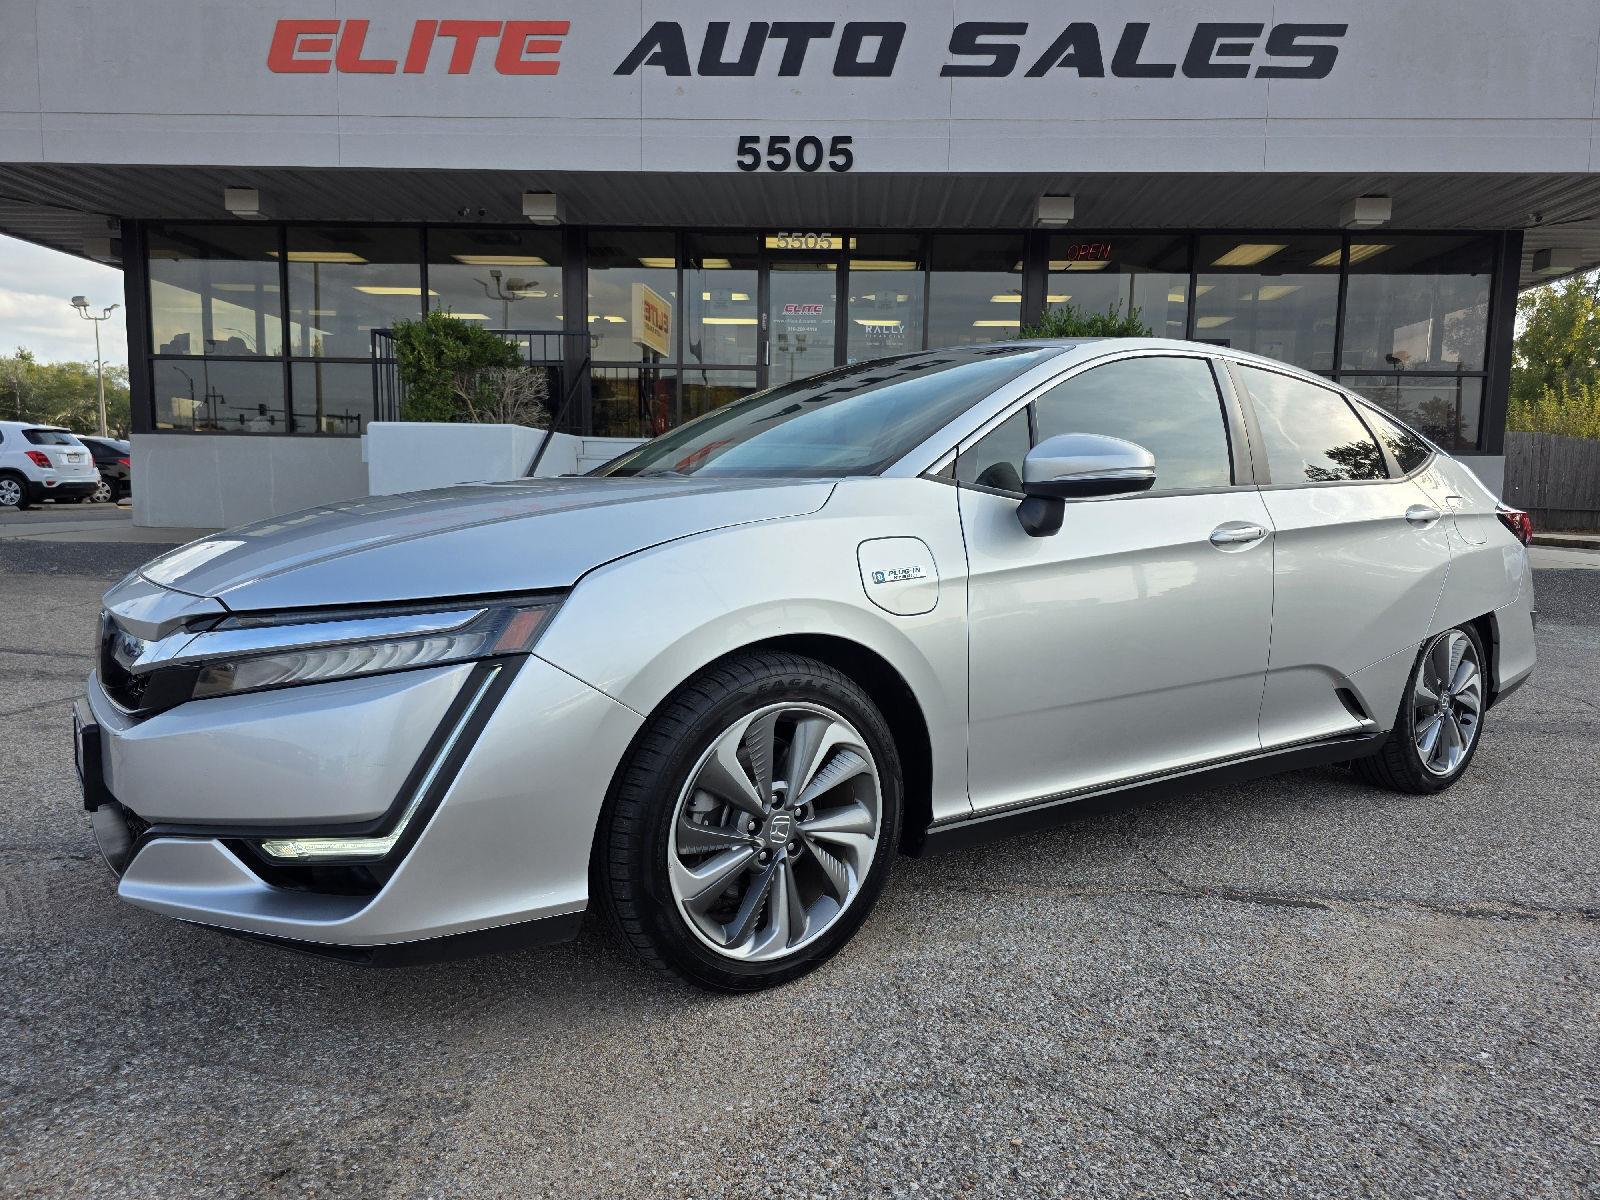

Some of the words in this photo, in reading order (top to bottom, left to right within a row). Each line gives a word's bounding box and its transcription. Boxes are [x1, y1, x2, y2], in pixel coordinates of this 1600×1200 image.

[267, 19, 569, 75] ELITE
[614, 21, 906, 77] AUTO
[940, 23, 1348, 79] SALES
[736, 135, 853, 172] 5505
[776, 232, 833, 250] 5505
[1067, 243, 1111, 261] OPEN
[784, 304, 823, 313] ELITE
[865, 325, 905, 334] RALLY
